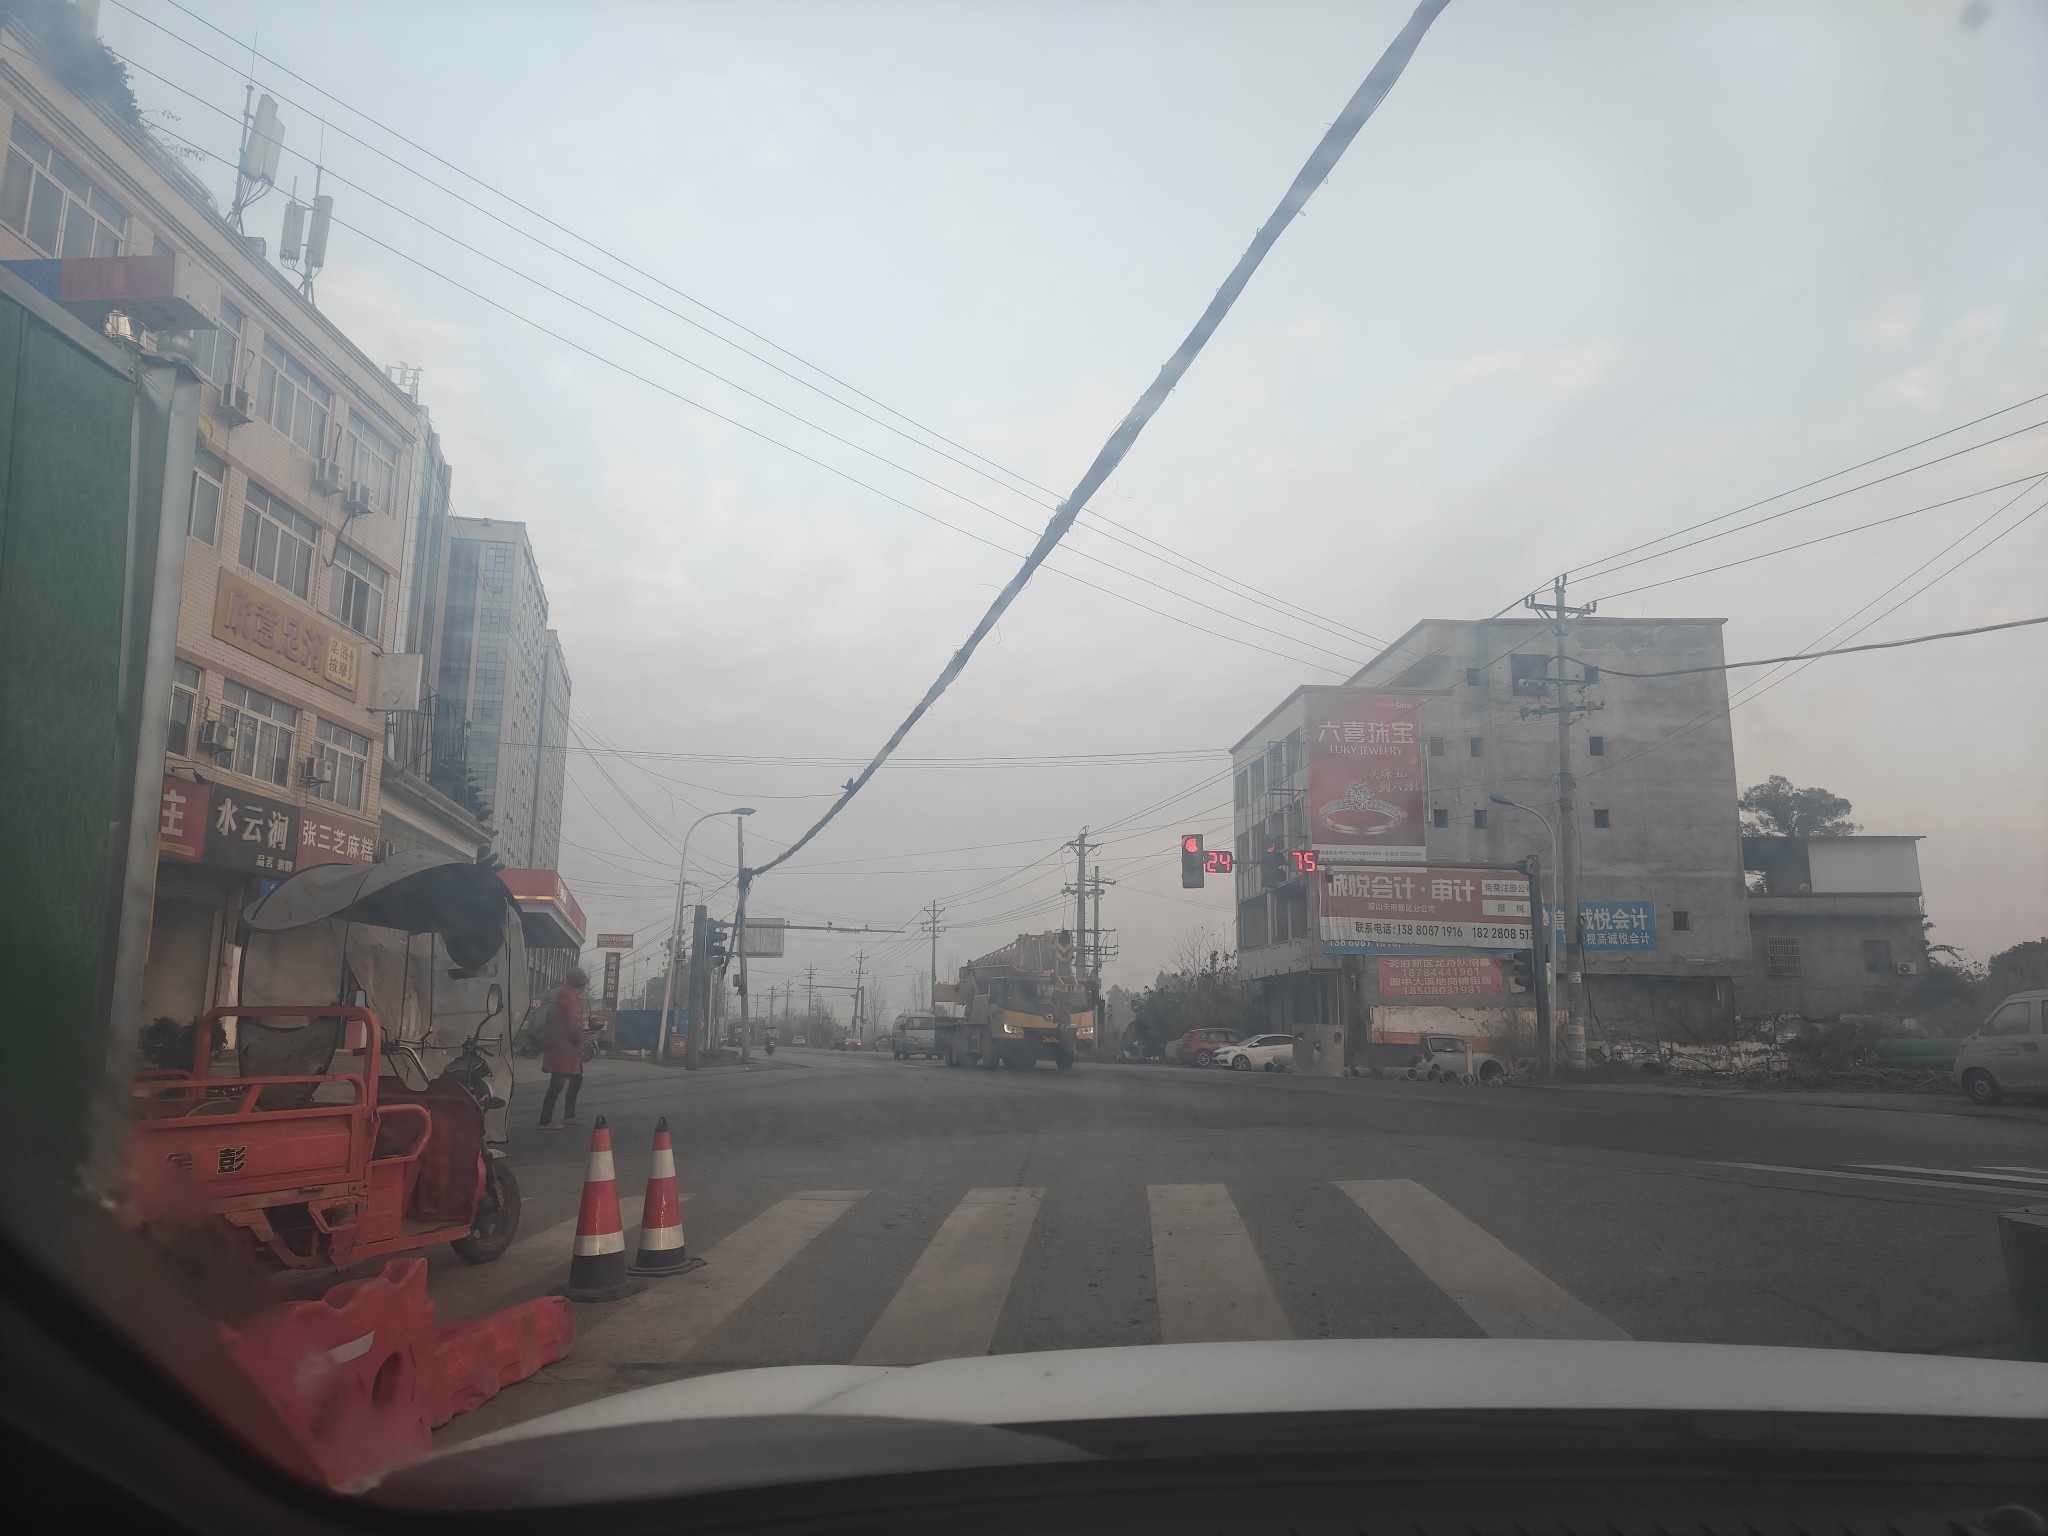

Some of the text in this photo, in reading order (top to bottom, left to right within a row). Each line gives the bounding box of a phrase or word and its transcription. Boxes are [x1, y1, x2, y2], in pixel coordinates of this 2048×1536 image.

[1319, 720, 1414, 744] 六喜珠宝
[1360, 746, 1403, 757] JEWELRY
[216, 798, 290, 851] 水云涧
[302, 820, 374, 862] 张三芝麻糕
[1206, 852, 1231, 872] 24
[1292, 852, 1316, 872] 75
[1416, 925, 1439, 936] 8087
[1442, 926, 1463, 938] 1916
[1472, 927, 1489, 939] 182
[1491, 928, 1517, 940] 2808
[1402, 968, 1480, 977] 18784441981
[1404, 986, 1480, 995] 18508031981
[217, 1145, 247, 1175] 彭
